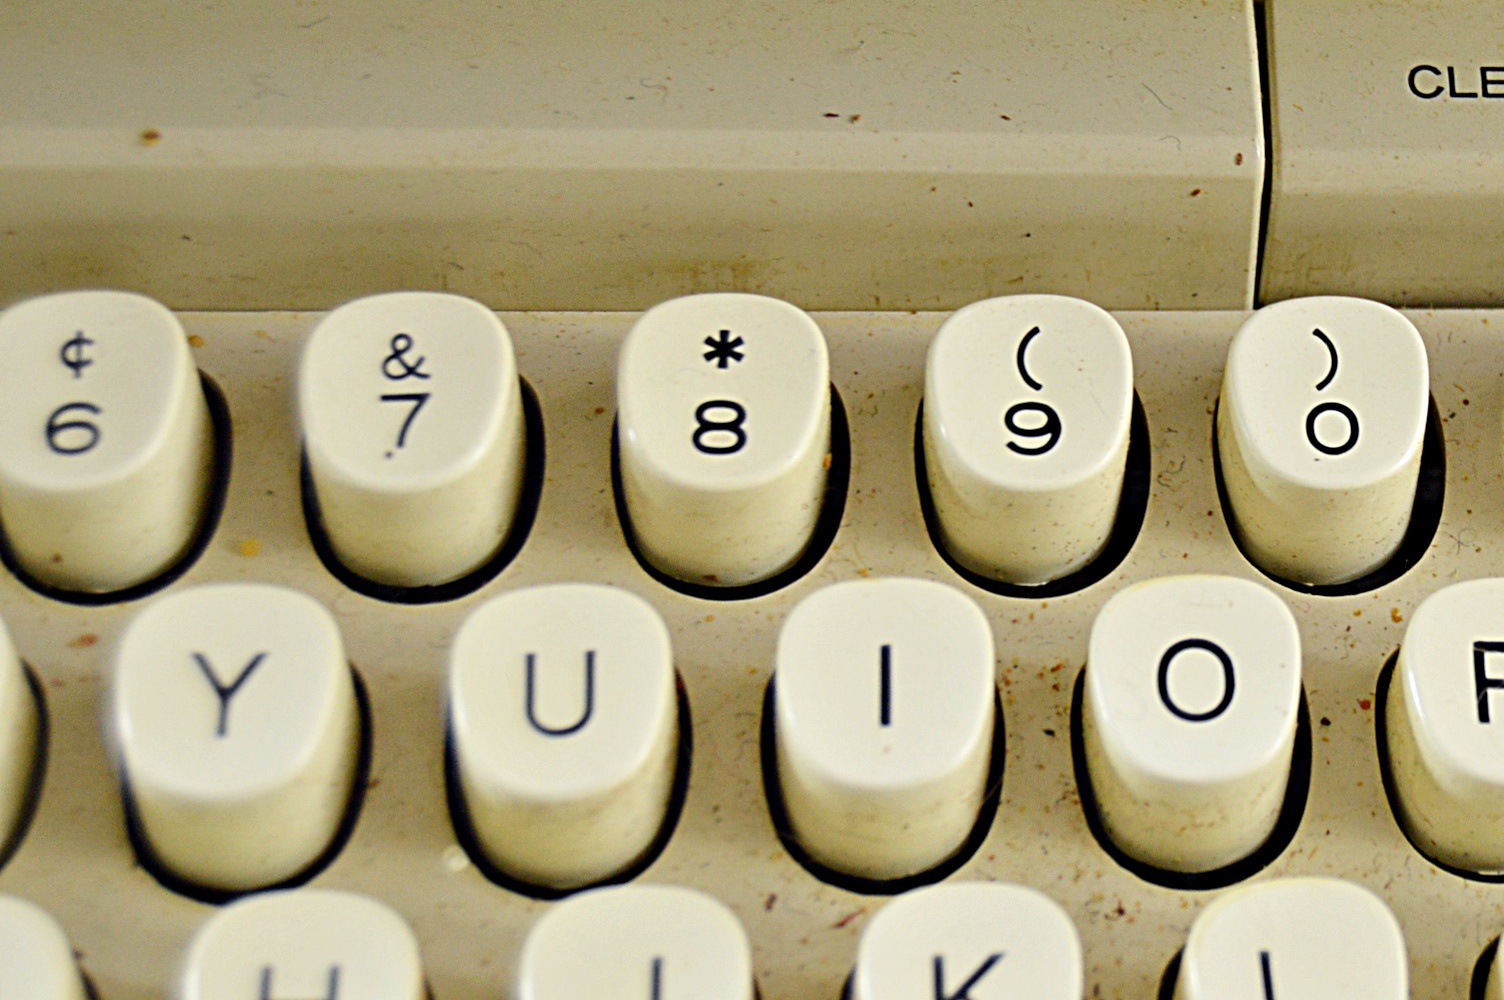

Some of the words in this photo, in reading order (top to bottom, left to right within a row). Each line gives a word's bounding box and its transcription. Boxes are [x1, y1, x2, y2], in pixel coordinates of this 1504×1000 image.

[381, 333, 431, 381] &
[45, 402, 102, 456] 6
[380, 392, 431, 449] 7
[691, 399, 748, 455] 8
[1004, 401, 1063, 456] 9
[193, 652, 268, 737] Y
[524, 650, 597, 737] U
[879, 644, 893, 728] I
[1156, 638, 1236, 723] O
